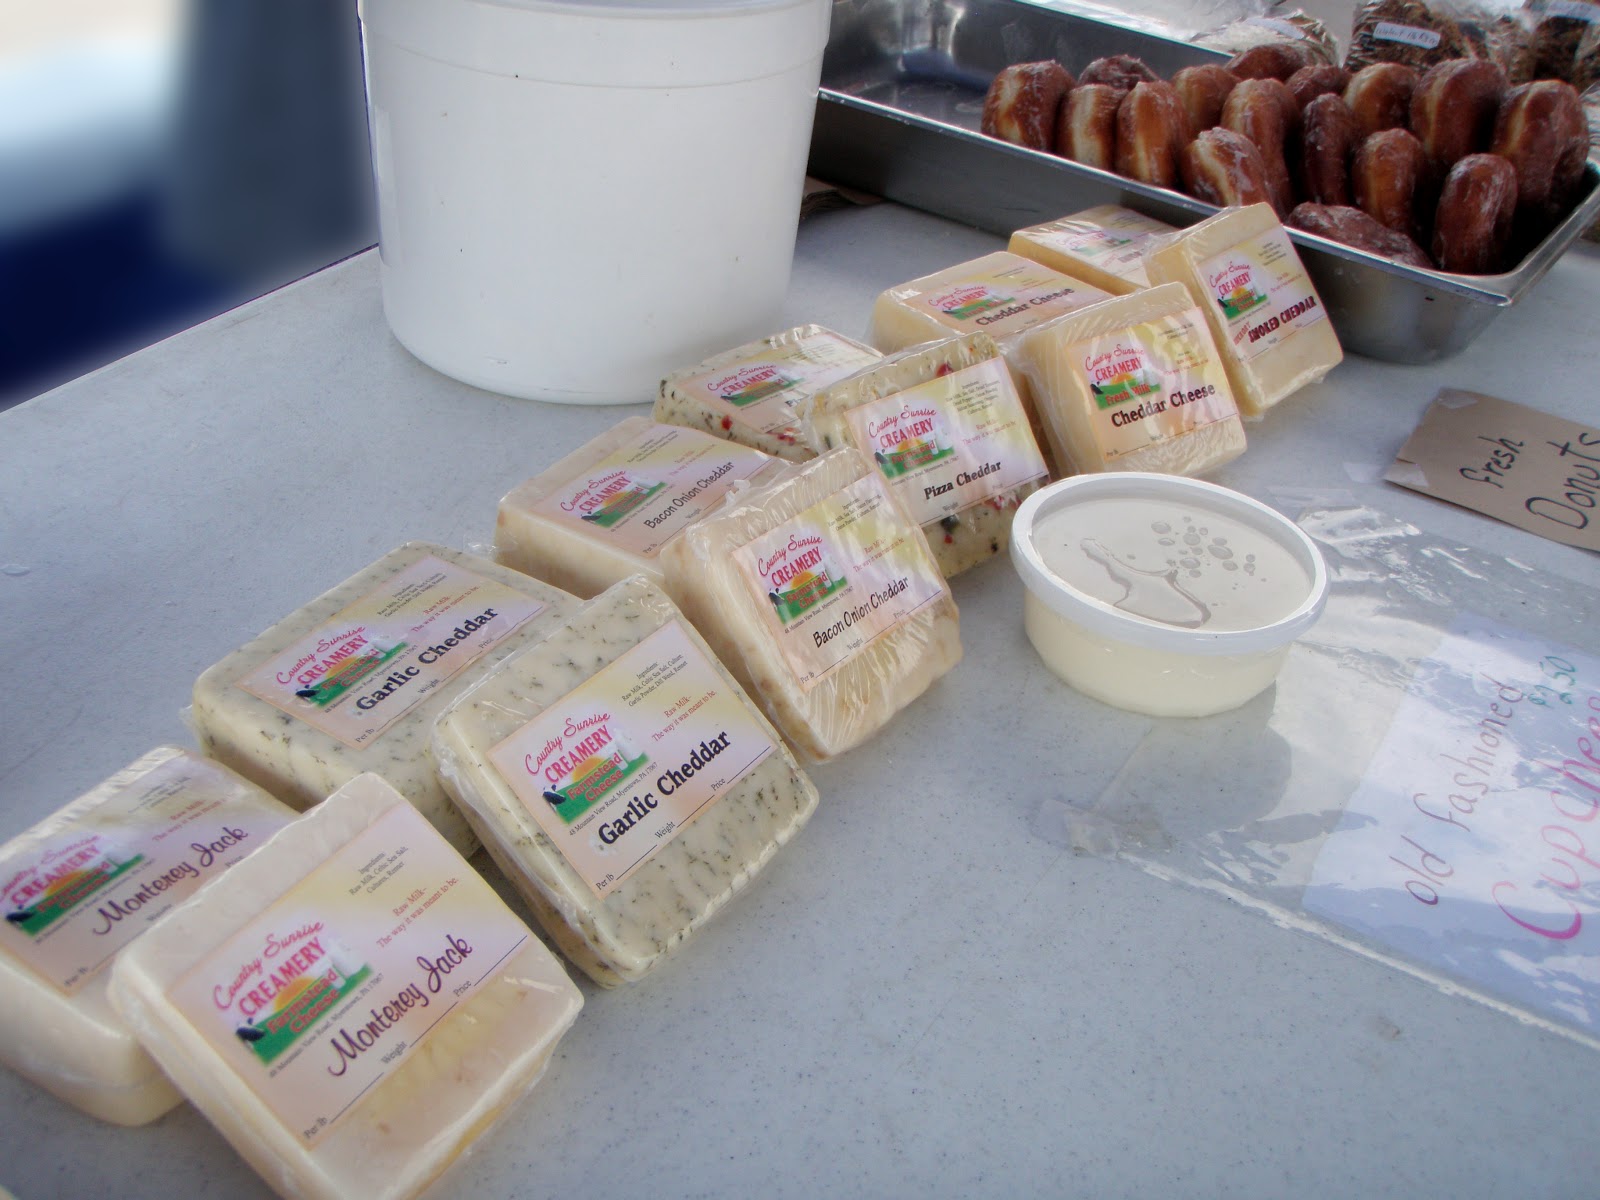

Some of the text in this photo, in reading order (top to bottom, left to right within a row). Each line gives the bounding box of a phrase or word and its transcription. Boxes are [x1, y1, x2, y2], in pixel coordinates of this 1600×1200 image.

[976, 287, 1075, 326] Cheddar Cheese
[1218, 271, 1252, 297] CREAMERY
[1248, 316, 1280, 343] SMOKED
[1280, 295, 1317, 324] CHEDDAR
[707, 373, 738, 391] Country
[722, 368, 777, 395] CREAMERY
[1095, 356, 1143, 382] CREAMERY
[1105, 383, 1151, 406] Fresh Milk
[1111, 383, 1216, 428] Cheddar Cheese
[868, 405, 936, 438] Country Sunrise
[880, 418, 933, 448] CREAMERY
[560, 489, 591, 512] Country
[579, 476, 631, 512] CREAMERY
[643, 504, 678, 530] Bacon
[678, 483, 701, 508] Onion
[695, 461, 736, 489] Cheddar
[924, 461, 1002, 500] Pizza Cheddar
[758, 534, 823, 577] Country Sunrise
[771, 546, 823, 587] CREAMERY
[786, 571, 828, 605] Farmstead
[812, 576, 909, 649] Bacon Onion Cheddar
[276, 626, 366, 685] Country Sunrise
[297, 634, 369, 685] CREAMERY
[321, 648, 381, 690] Farmstead
[340, 659, 381, 687] Cheese
[356, 606, 498, 711] Garlic Cheddar
[355, 732, 370, 744] Per
[417, 677, 441, 695] Weight
[651, 731, 665, 742] The
[663, 722, 676, 733] way
[678, 712, 689, 722] was
[687, 699, 704, 715] meant
[702, 694, 710, 703] to
[664, 707, 677, 718] Raw
[525, 712, 611, 776] Country Sunrise
[544, 724, 613, 783] CREAMERY
[567, 752, 624, 801] Farmstead
[585, 769, 624, 802] Cheese
[597, 730, 731, 845] Garlic Cheddar
[575, 813, 596, 831] Mountain
[593, 805, 606, 816] View
[638, 771, 648, 781] PA
[595, 777, 726, 891] Per lb Weight Price
[11, 844, 100, 905] CREAMERY
[93, 861, 200, 935] Monterey
[190, 826, 249, 867] Jack
[376, 935, 393, 948] The
[391, 923, 407, 936] way
[410, 907, 425, 919] was
[422, 890, 443, 909] meant
[440, 885, 449, 894] to
[392, 903, 409, 917] Raw
[213, 921, 325, 1012] Country Sunrise
[239, 936, 326, 1017] CREAMERY
[266, 967, 338, 1034] Farmstead
[290, 988, 341, 1034] Cheese
[327, 934, 473, 1077] Monterey Jack
[303, 979, 473, 1140] Per lb Weight Price
